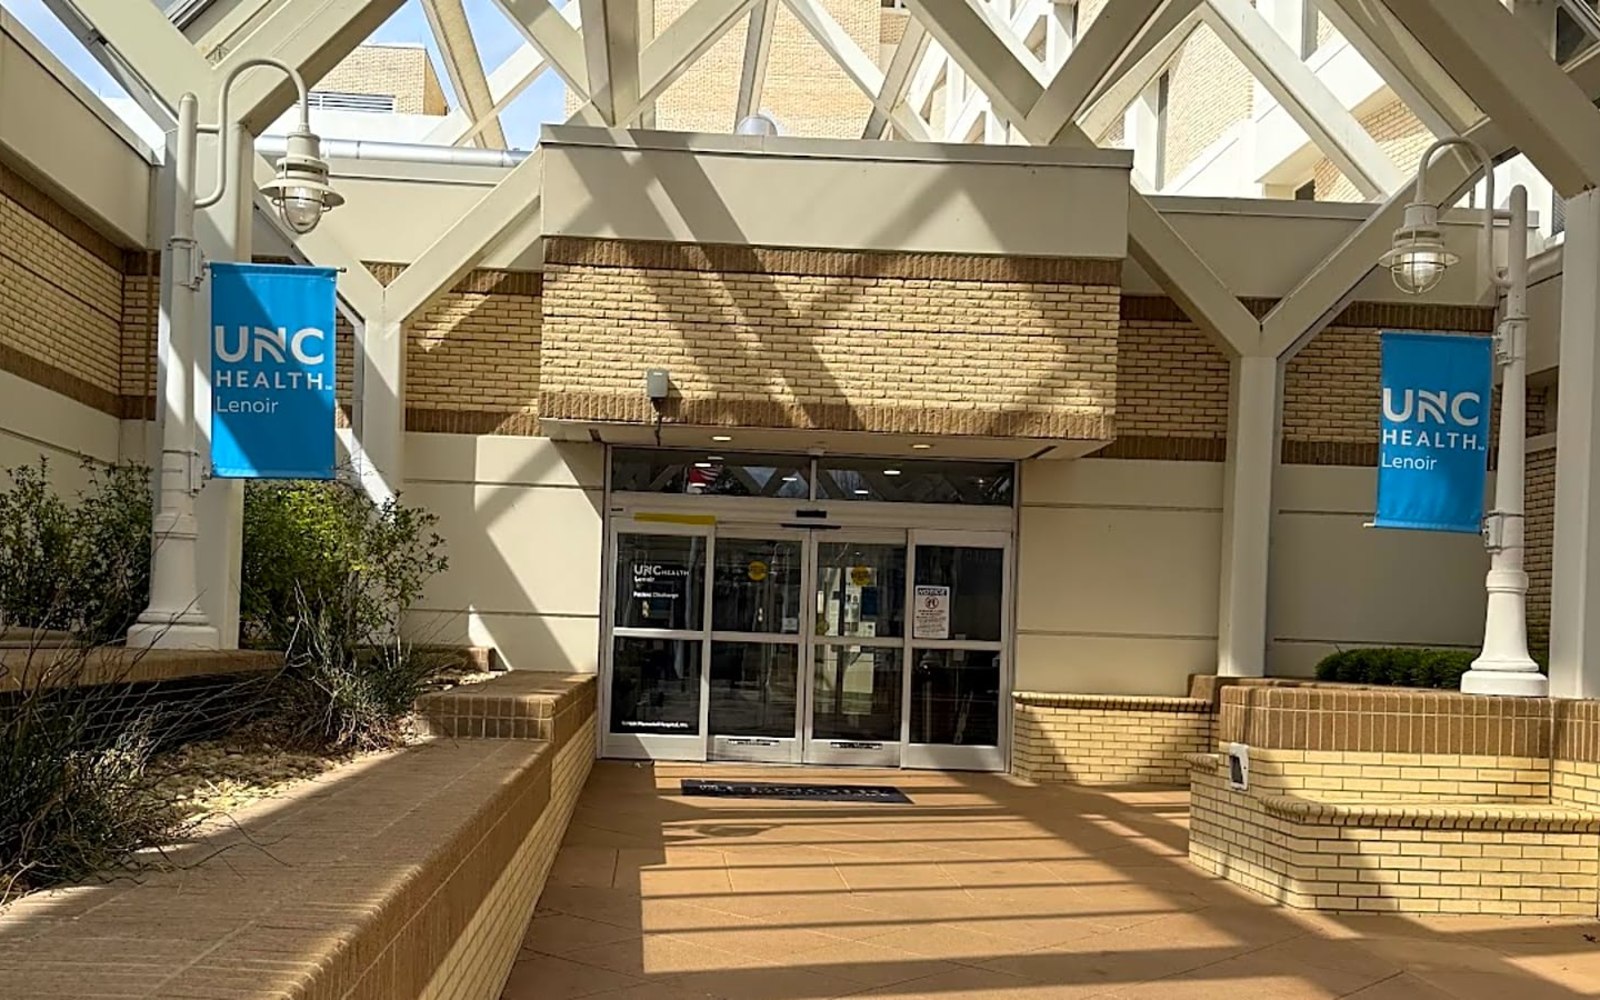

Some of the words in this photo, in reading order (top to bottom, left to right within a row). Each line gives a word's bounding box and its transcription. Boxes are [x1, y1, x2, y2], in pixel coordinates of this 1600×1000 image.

[214, 325, 325, 365] UNC
[216, 370, 323, 390] HEALTH
[216, 396, 279, 413] Lenoir
[1382, 387, 1481, 427] UNC
[1382, 429, 1477, 450] HEALTH
[1381, 452, 1438, 470] Lenoir
[633, 564, 662, 576] UNC
